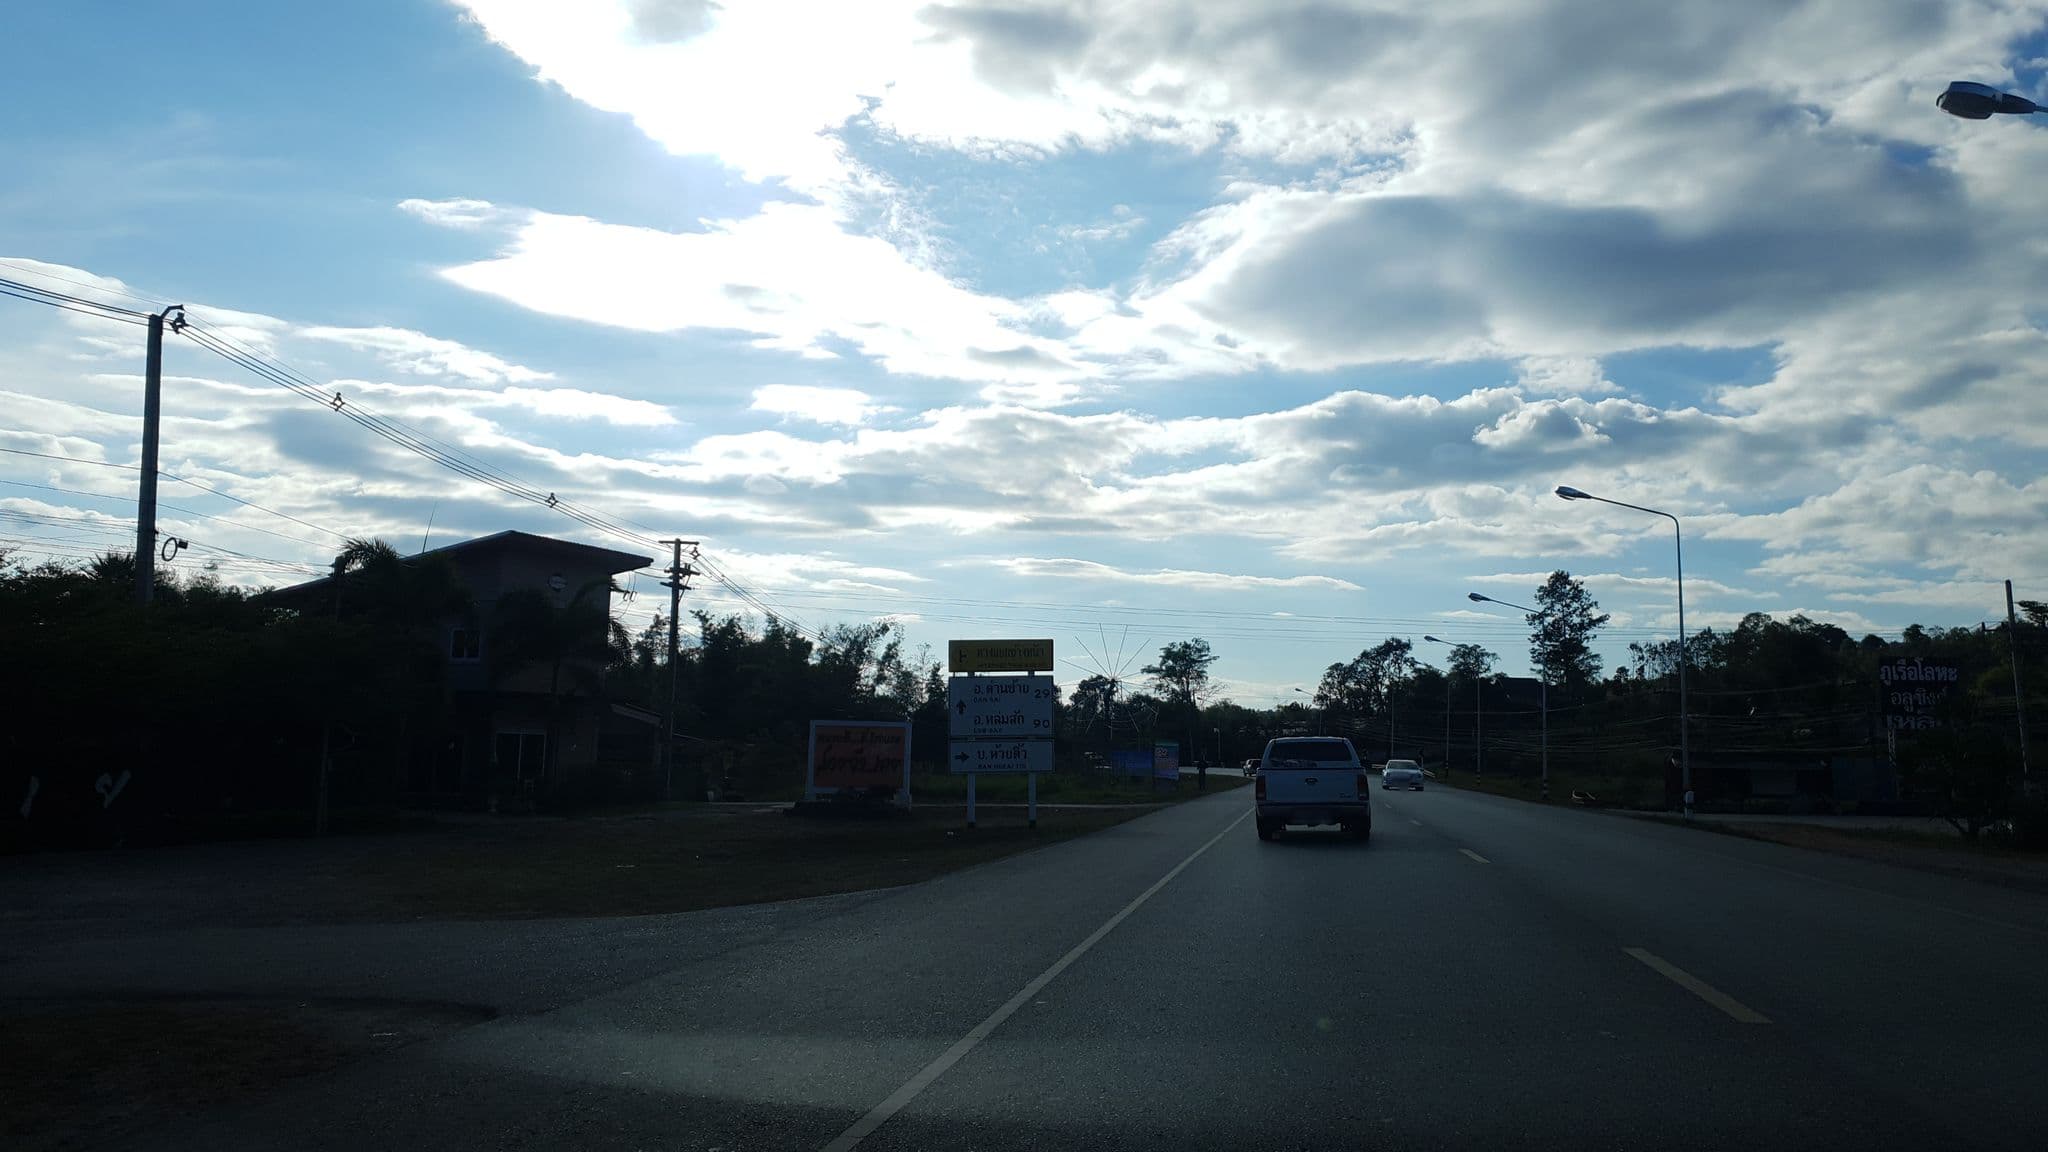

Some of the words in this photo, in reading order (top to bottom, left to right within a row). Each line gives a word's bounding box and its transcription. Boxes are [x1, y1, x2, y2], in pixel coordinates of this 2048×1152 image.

[1880, 657, 1957, 687] ภูเรือโลหะ
[1034, 689, 1050, 699] 29
[1033, 719, 1050, 728] 90
